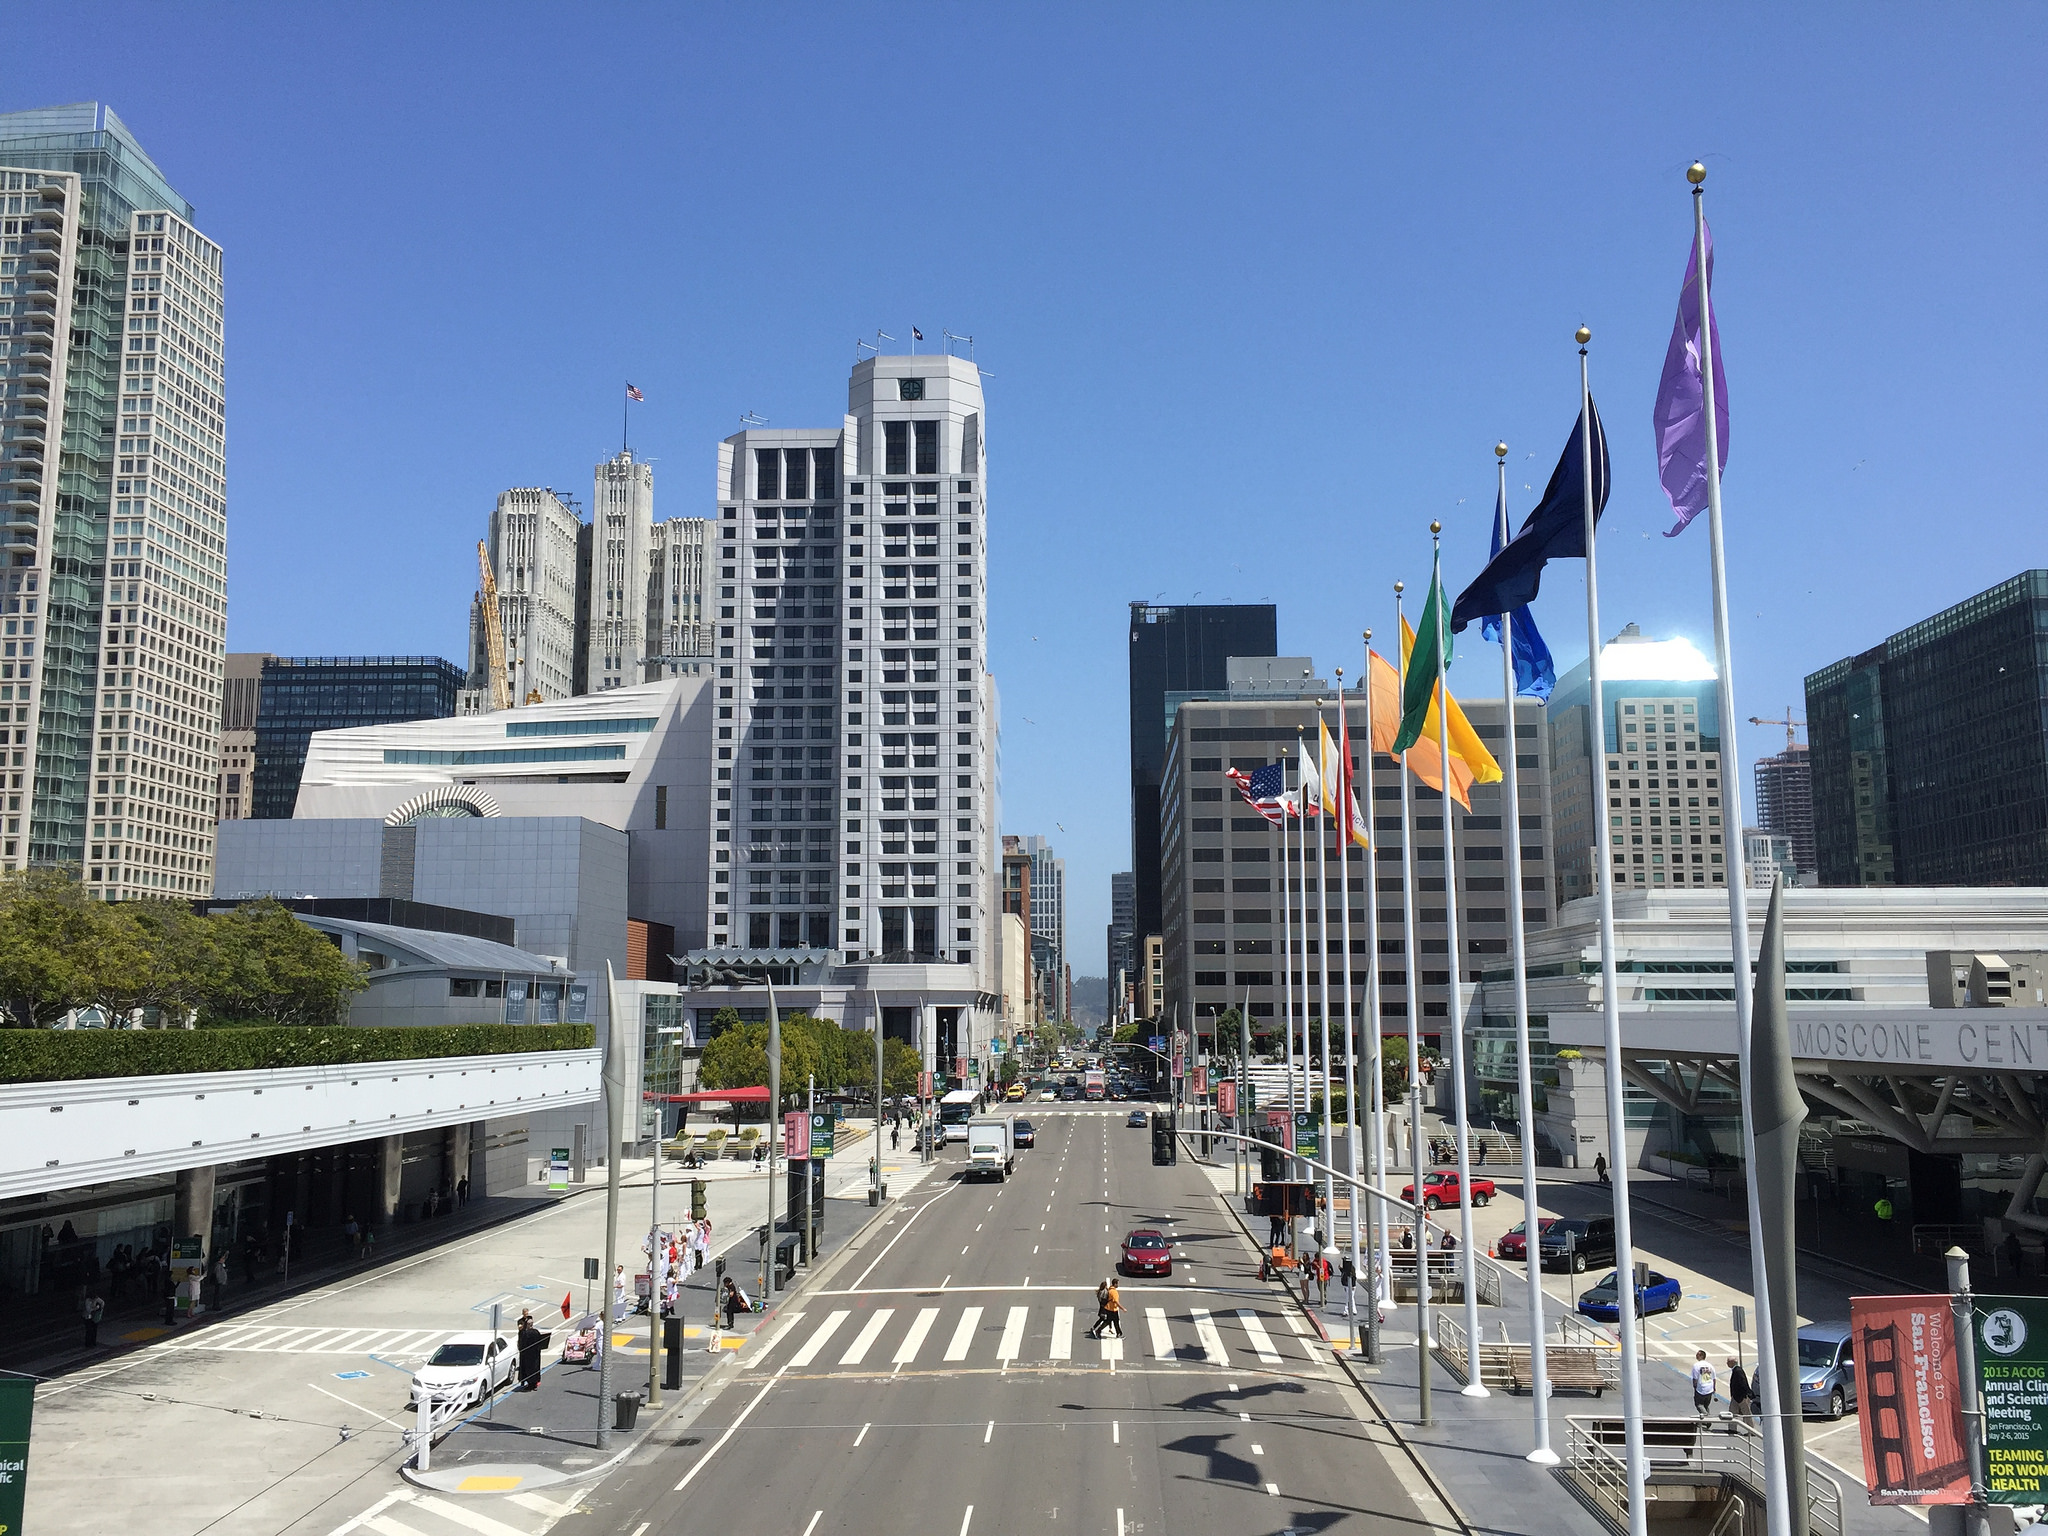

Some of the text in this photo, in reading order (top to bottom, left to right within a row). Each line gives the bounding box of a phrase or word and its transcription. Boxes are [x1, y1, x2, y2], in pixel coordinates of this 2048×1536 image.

[1796, 1023, 1932, 1060] MOSCONE
[1930, 1313, 1945, 1400] Welcome to
[1983, 1366, 2046, 1378] 2015 ACOG
[1911, 1313, 1936, 1459] San Francisco
[1985, 1379, 2024, 1392] Annual
[1986, 1392, 2005, 1405] and
[1988, 1406, 2032, 1421] Meeting
[1988, 1422, 2043, 1431] San Francisco, CA
[2000, 1432, 2013, 1440] 2-6,
[2013, 1432, 2030, 1440] 2015
[1988, 1449, 2045, 1462] TEAMING
[1989, 1464, 2015, 1477] FOR
[1991, 1478, 2041, 1491] HEALTH
